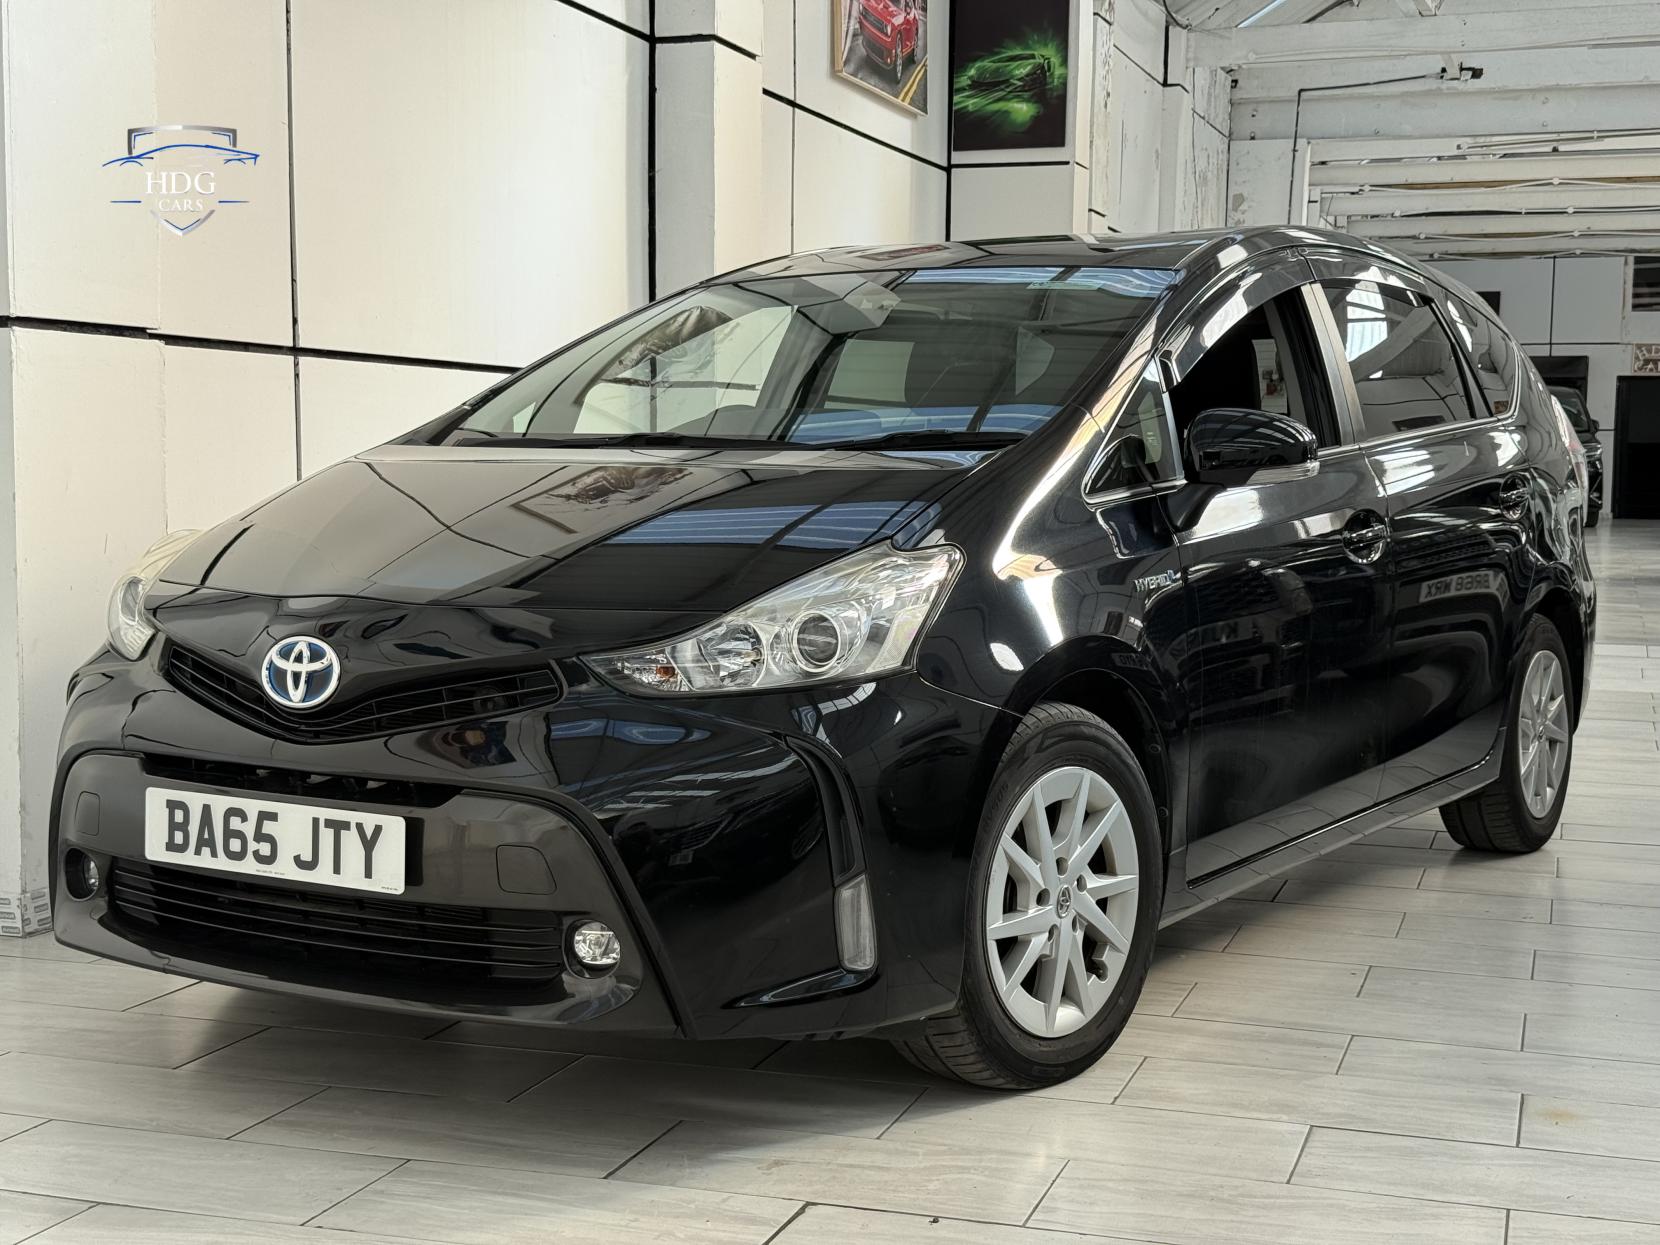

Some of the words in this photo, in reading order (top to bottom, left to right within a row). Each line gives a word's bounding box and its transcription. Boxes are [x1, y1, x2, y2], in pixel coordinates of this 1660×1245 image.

[1133, 573, 1172, 592] HYBRID
[165, 799, 279, 866] BA65
[293, 816, 383, 880] JTY
